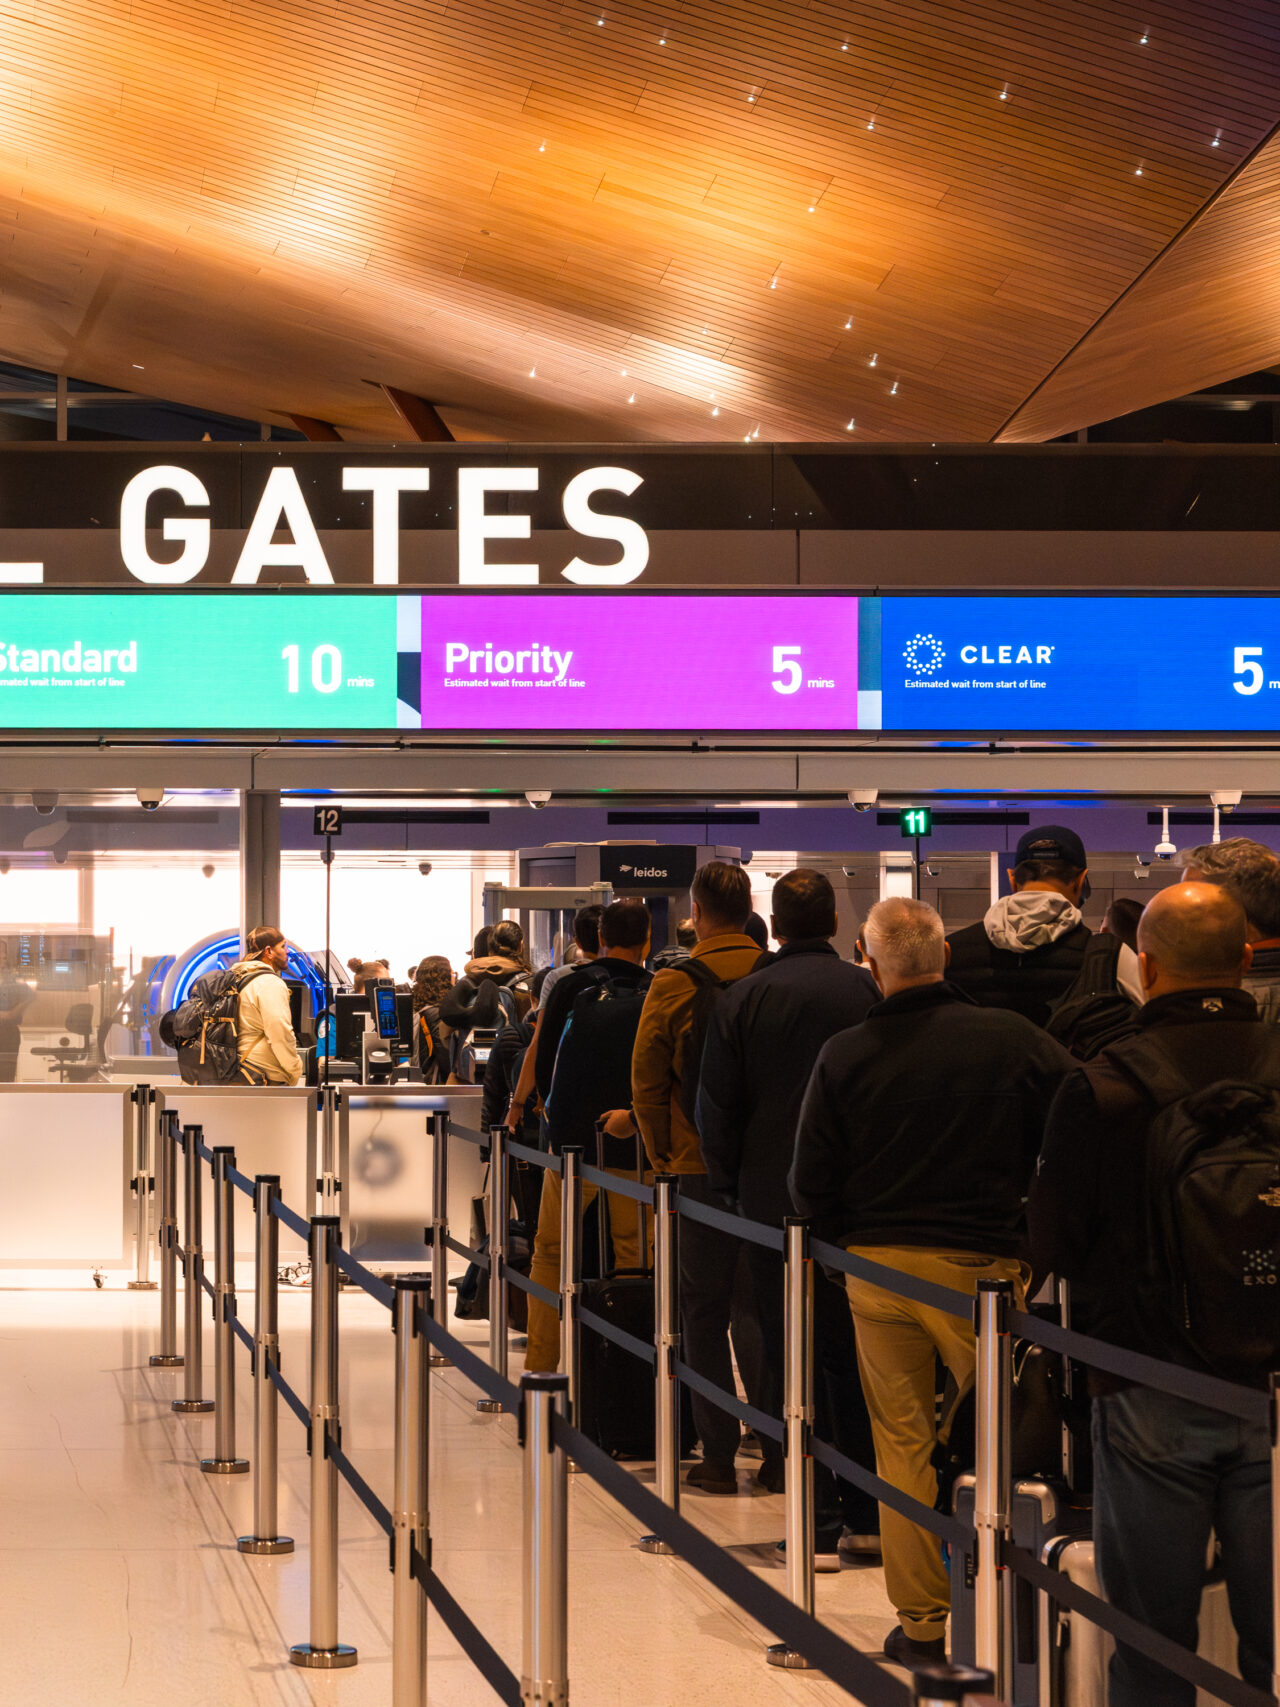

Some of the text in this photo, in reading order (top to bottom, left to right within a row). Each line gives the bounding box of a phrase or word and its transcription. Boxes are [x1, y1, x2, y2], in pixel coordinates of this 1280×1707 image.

[120, 465, 650, 584] GATES
[445, 642, 574, 682] Priority
[960, 645, 1054, 664] CLEAR
[281, 643, 375, 694] 10 mins
[771, 645, 835, 695] 5 mins
[1232, 646, 1264, 695] 5
[30, 677, 49, 687] wait
[51, 677, 72, 687] from
[74, 677, 96, 687] start
[97, 677, 107, 687] of
[108, 677, 125, 687] line
[444, 678, 586, 688] Estimated wait from start of line
[905, 679, 1047, 688] Estimated wait from start of line
[316, 809, 339, 831] 12
[904, 810, 926, 834] 11
[633, 866, 668, 878] leidos
